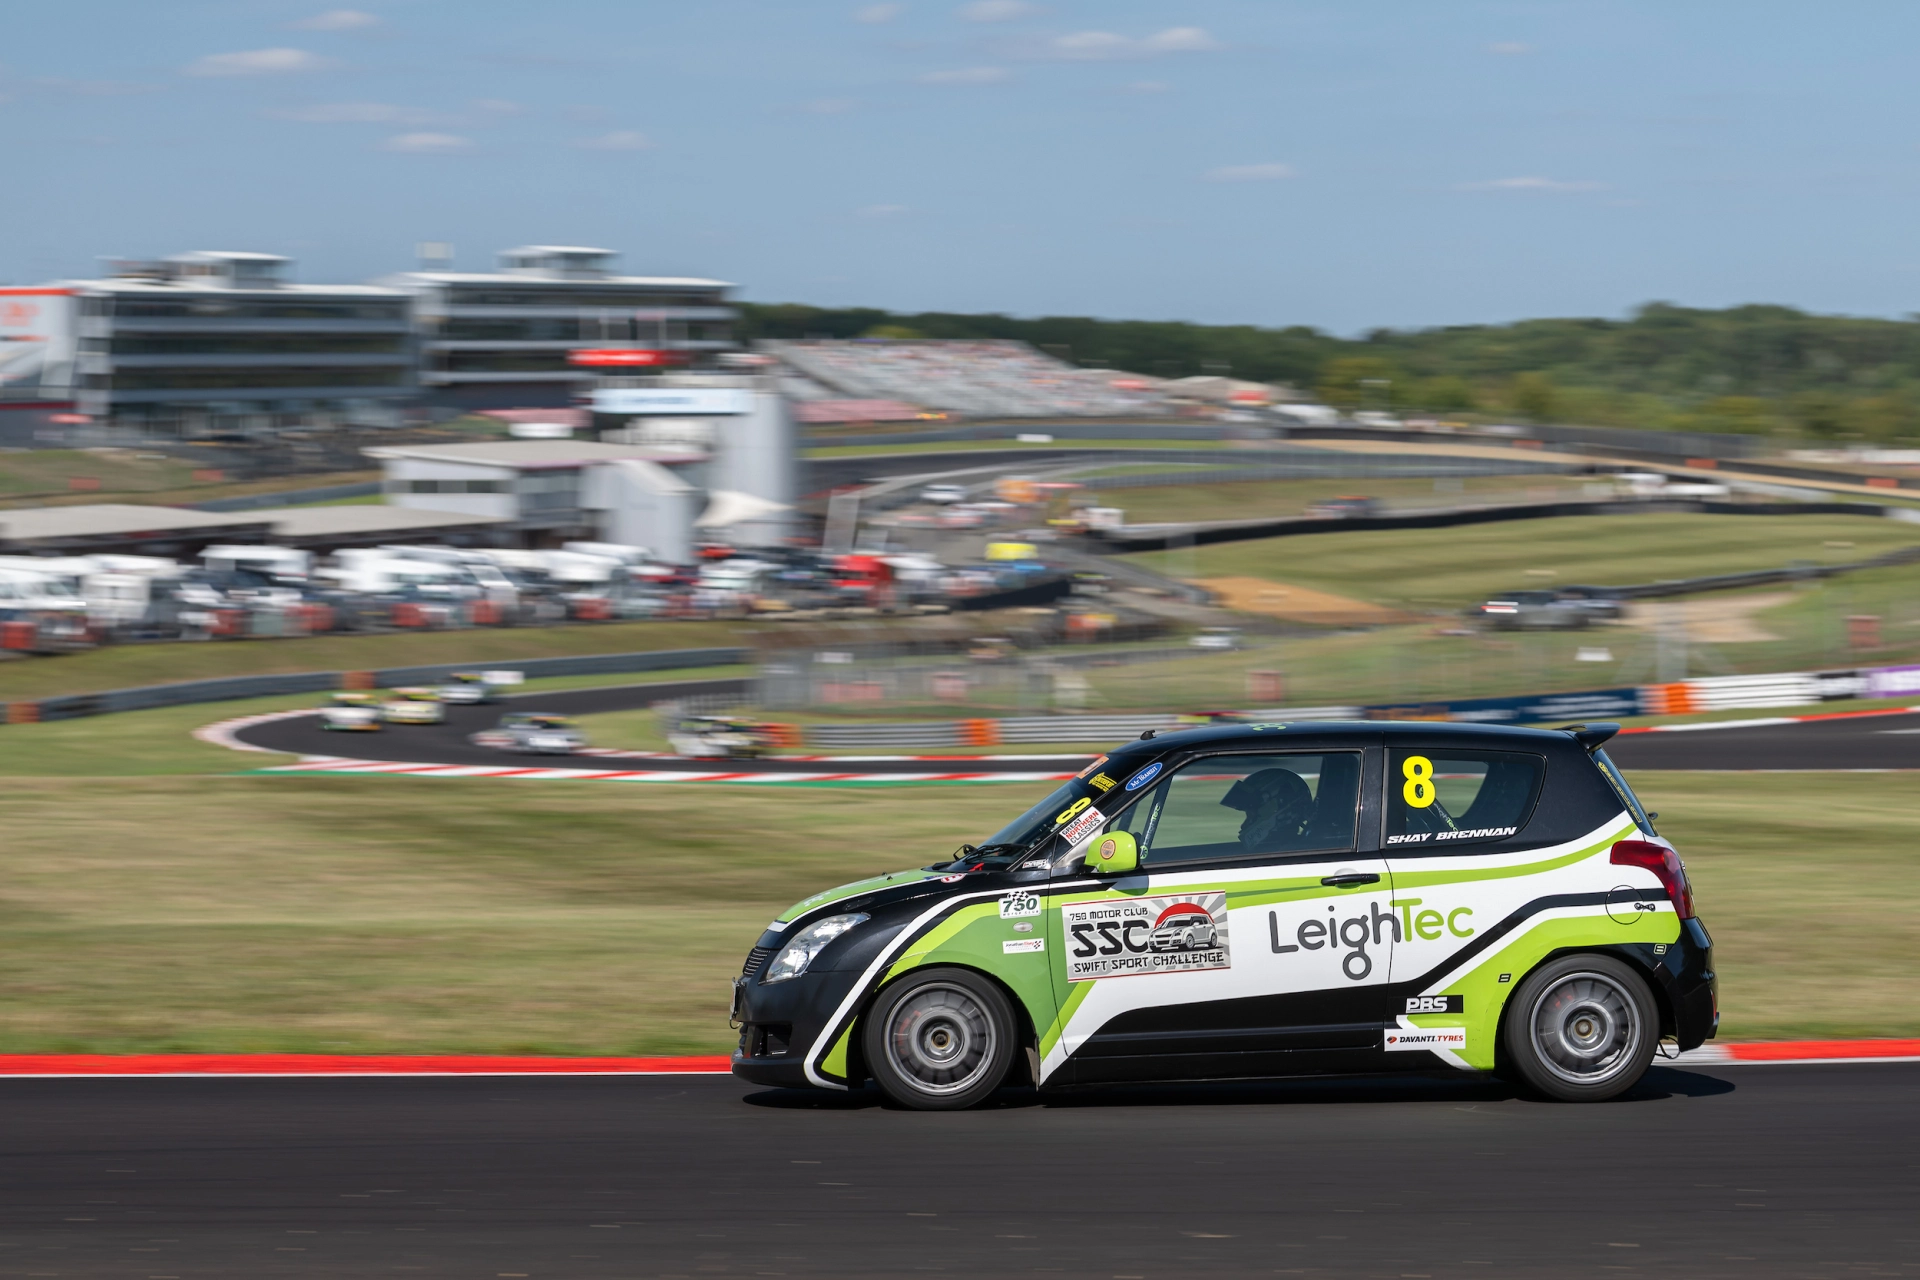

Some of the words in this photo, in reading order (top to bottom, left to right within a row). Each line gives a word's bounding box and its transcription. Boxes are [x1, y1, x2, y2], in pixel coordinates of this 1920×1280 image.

[1402, 755, 1436, 809] 8
[1056, 797, 1092, 824] 8
[1061, 818, 1081, 835] GREAT
[1065, 810, 1099, 839] NORTHERN
[1070, 817, 1101, 844] CLASSICS
[1386, 832, 1432, 844] SHAY
[1435, 826, 1517, 840] BRENNAN
[1002, 897, 1038, 913] 750
[1069, 913, 1087, 922] 750
[1089, 909, 1121, 920] MOTOR
[1123, 907, 1148, 917] CLUB
[1070, 919, 1150, 958] SSC
[1269, 898, 1475, 981] LeighTec
[1074, 960, 1108, 973] SWIFT
[1111, 957, 1149, 970] SPORT
[1152, 951, 1224, 966] CHALLENGE
